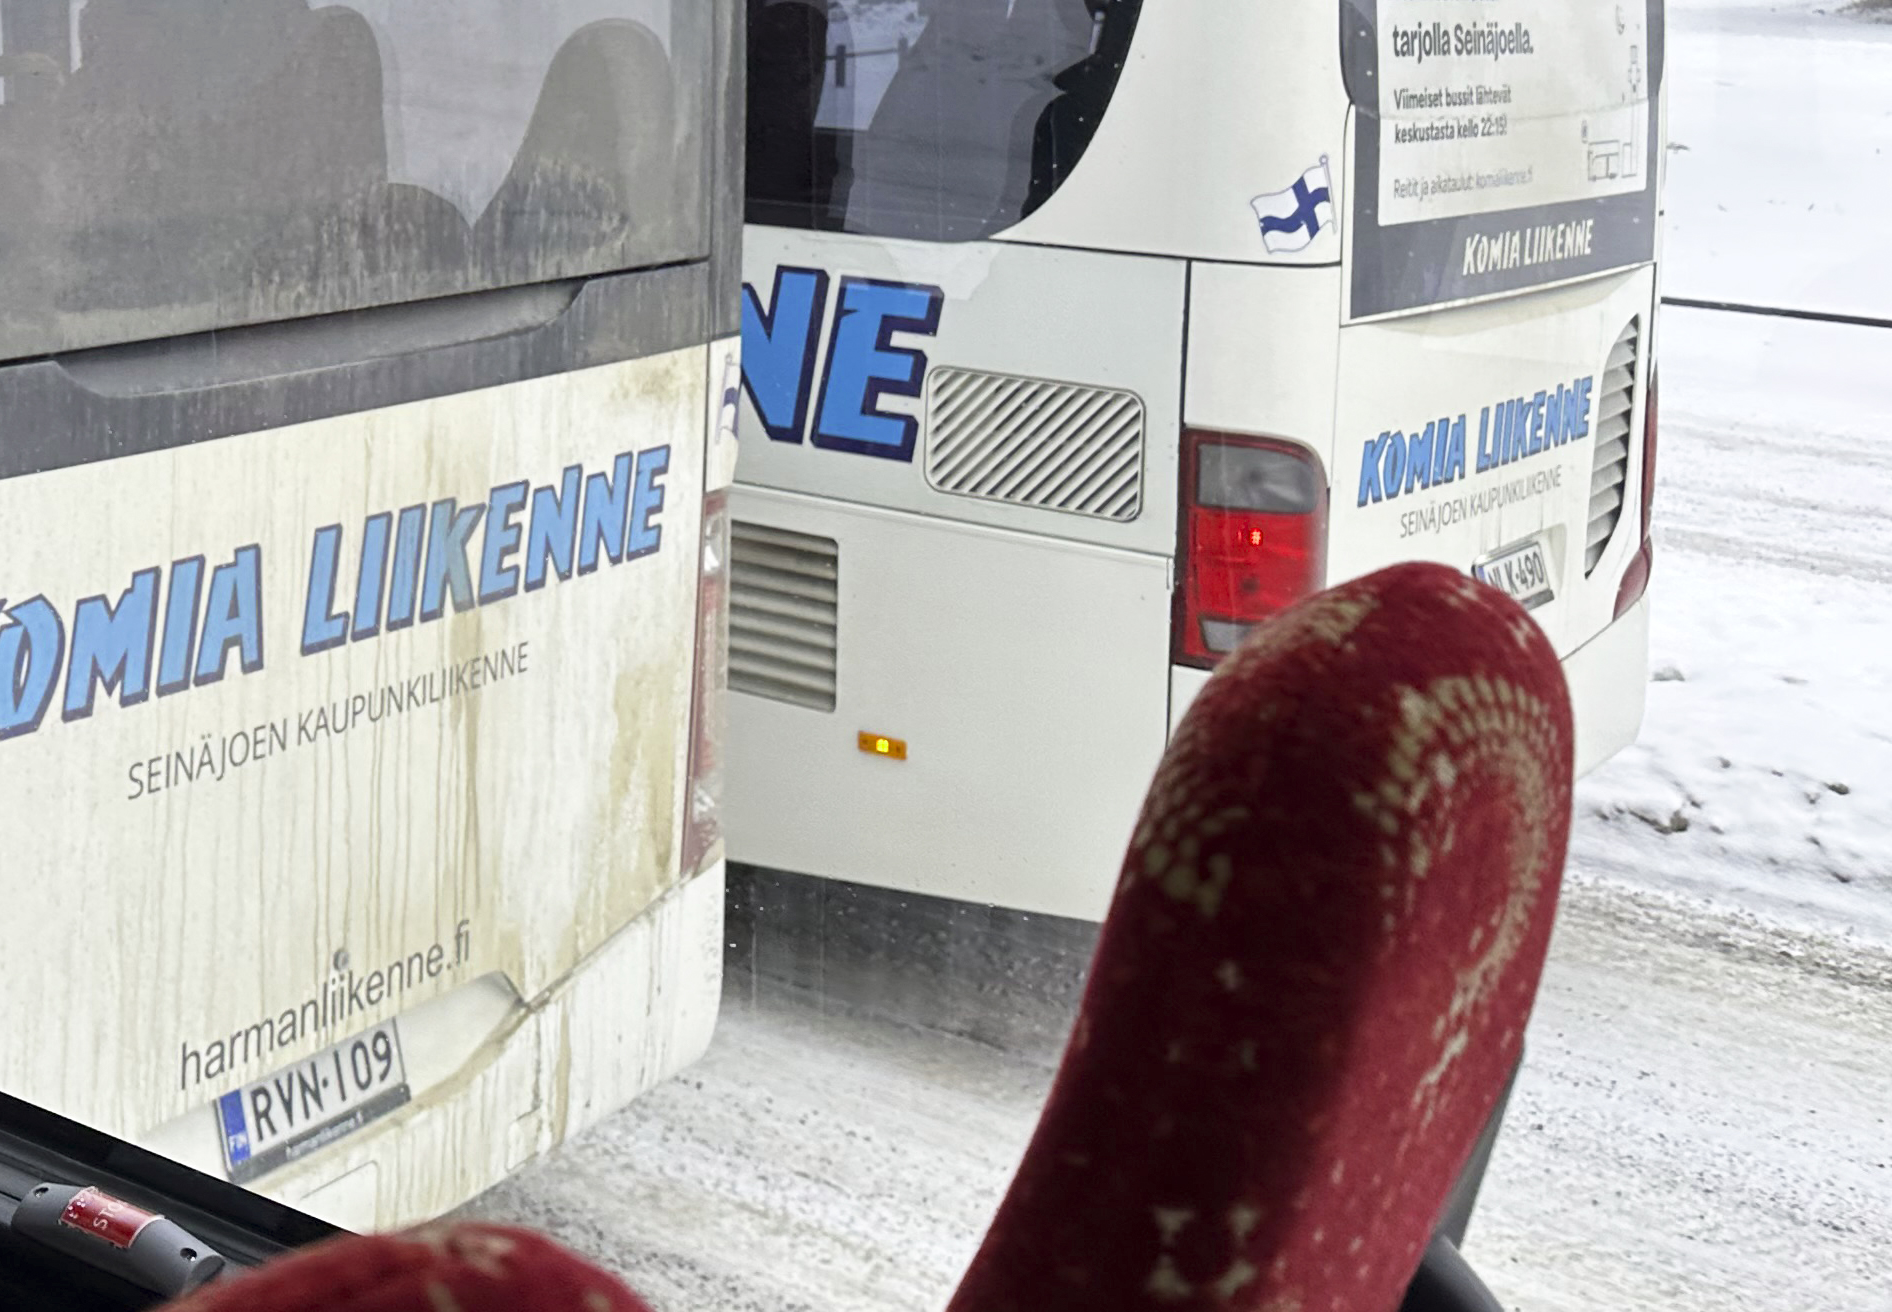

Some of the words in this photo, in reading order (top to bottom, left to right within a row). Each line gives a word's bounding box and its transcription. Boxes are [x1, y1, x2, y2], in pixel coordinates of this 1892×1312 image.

[1392, 21, 1451, 64] tarjolla
[1454, 21, 1534, 62] Seinäjoella.
[1393, 87, 1444, 110] Viimeiset
[1445, 85, 1475, 107] bussit
[1394, 119, 1455, 144] keskustasta
[1457, 118, 1479, 138] kello
[1462, 230, 1521, 276] KOMIA
[1523, 218, 1594, 266] LIIKENNE
[1357, 413, 1467, 509] KOMIA
[1475, 375, 1594, 475] LIIKENNE
[1399, 497, 1469, 539] SEINÄJOEN
[1469, 464, 1563, 518] KAUPUNKILIIKENNE
[300, 444, 671, 657] LIIKENNE
[126, 718, 289, 801] SEINÄJOEN
[296, 641, 529, 747] KAUPUNKILIIKENNE
[180, 919, 470, 1091] harmanliikenne.fi
[250, 1030, 393, 1143] RVN-109
[92, 1201, 125, 1231] STO
